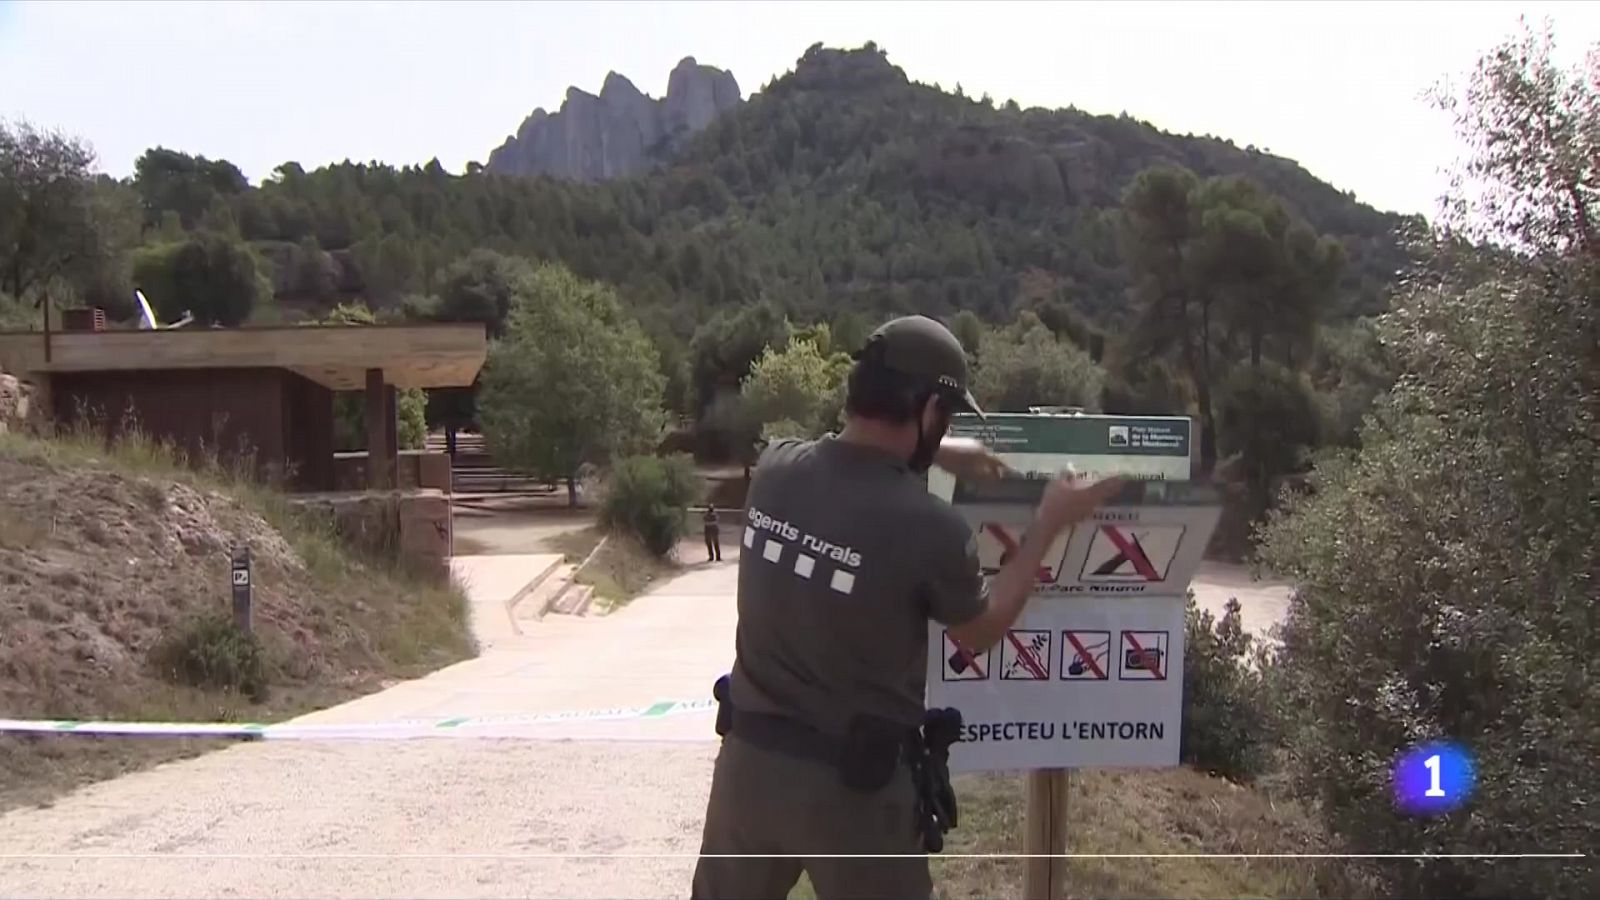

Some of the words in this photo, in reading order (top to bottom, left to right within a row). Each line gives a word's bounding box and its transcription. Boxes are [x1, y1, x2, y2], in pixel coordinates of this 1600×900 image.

[748, 506, 799, 541] agents
[801, 533, 862, 567] rurals
[958, 721, 1055, 743] ESPECTEU
[1061, 721, 1164, 740] L'ENTORN
